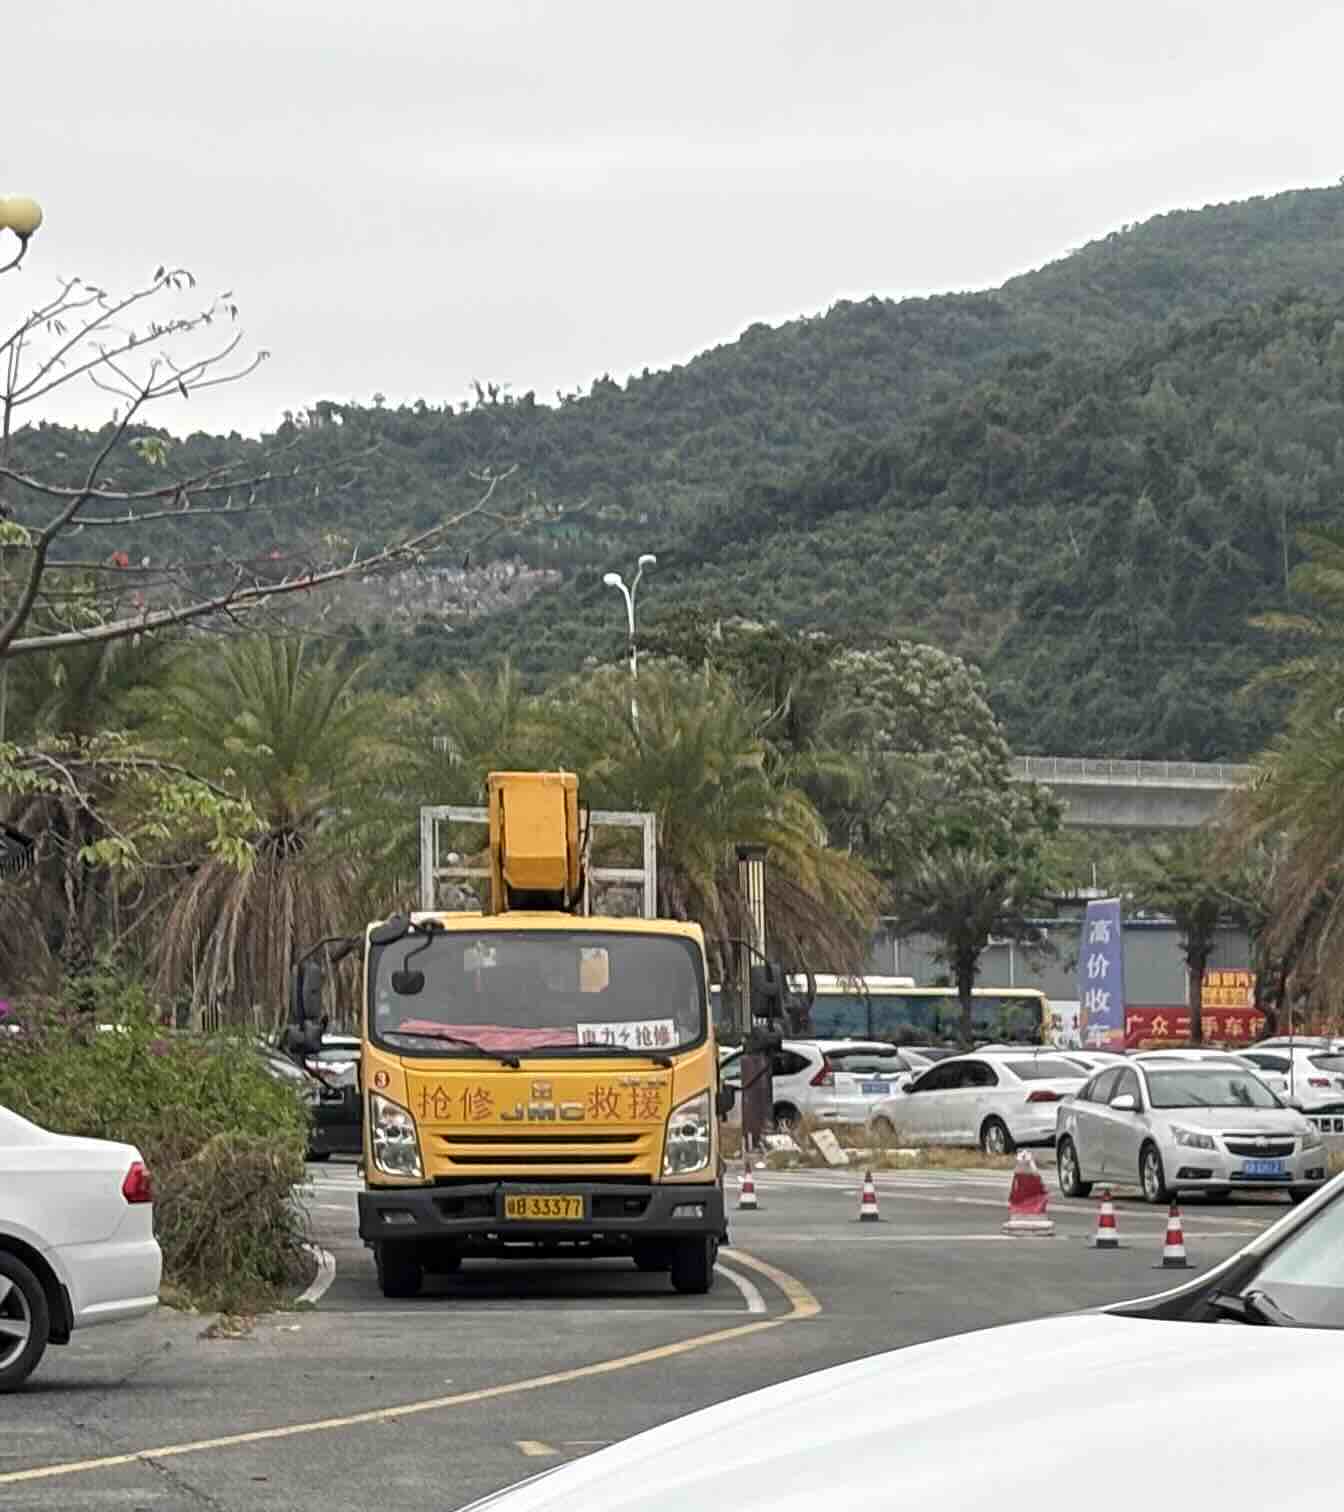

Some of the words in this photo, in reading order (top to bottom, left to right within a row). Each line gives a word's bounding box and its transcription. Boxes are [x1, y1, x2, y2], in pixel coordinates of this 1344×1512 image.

[416, 1085, 495, 1121] 抢修
[500, 1102, 586, 1121] JMC
[588, 1084, 662, 1121] 救援
